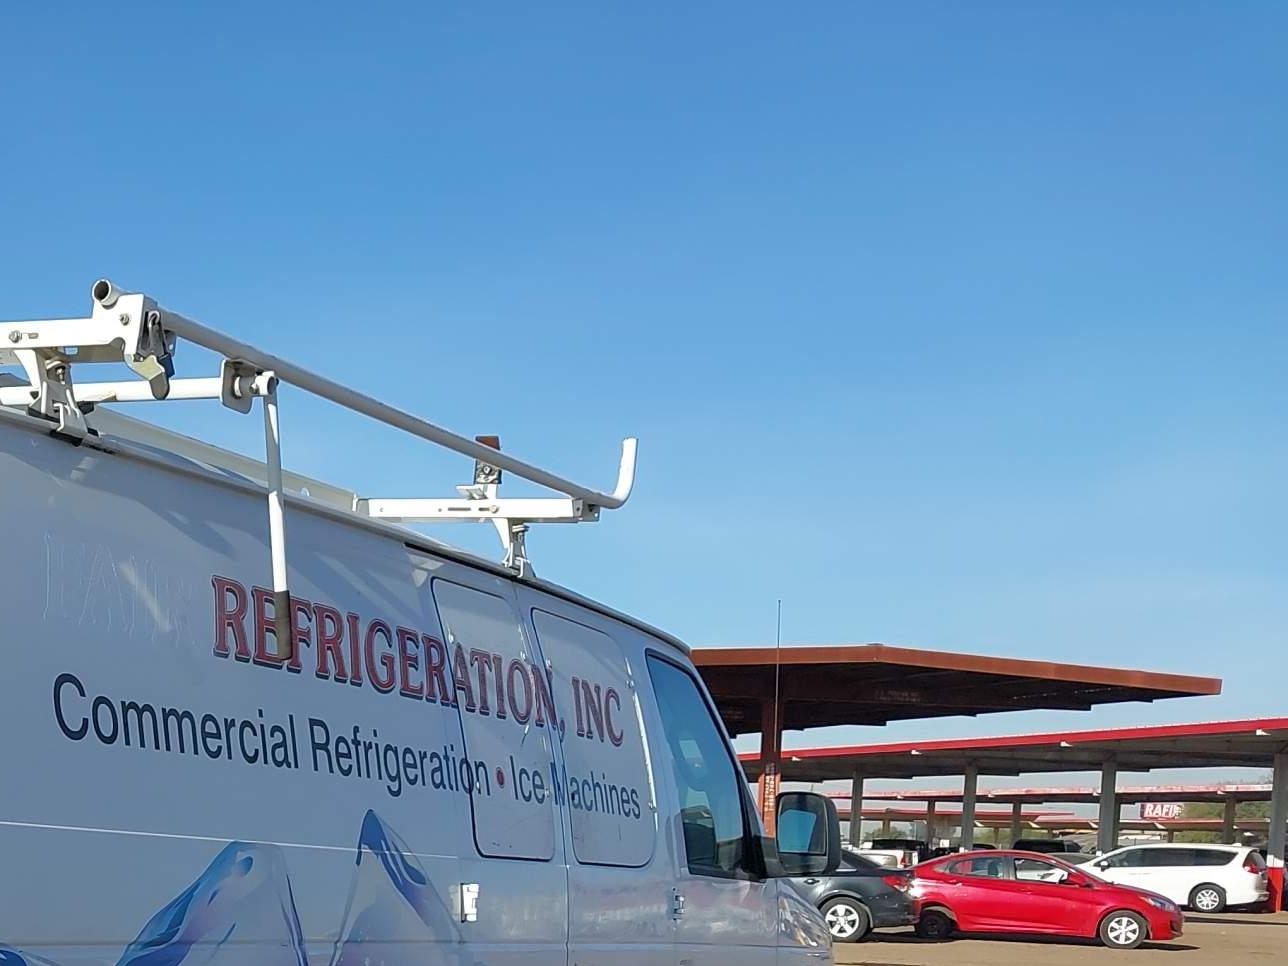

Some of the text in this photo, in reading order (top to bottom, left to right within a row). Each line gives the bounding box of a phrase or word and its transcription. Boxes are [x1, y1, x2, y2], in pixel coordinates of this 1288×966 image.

[211, 574, 566, 743] REFRIGERATION,
[571, 675, 624, 748] INC
[53, 672, 642, 820] Commercial Refrigeration Ice Machines
